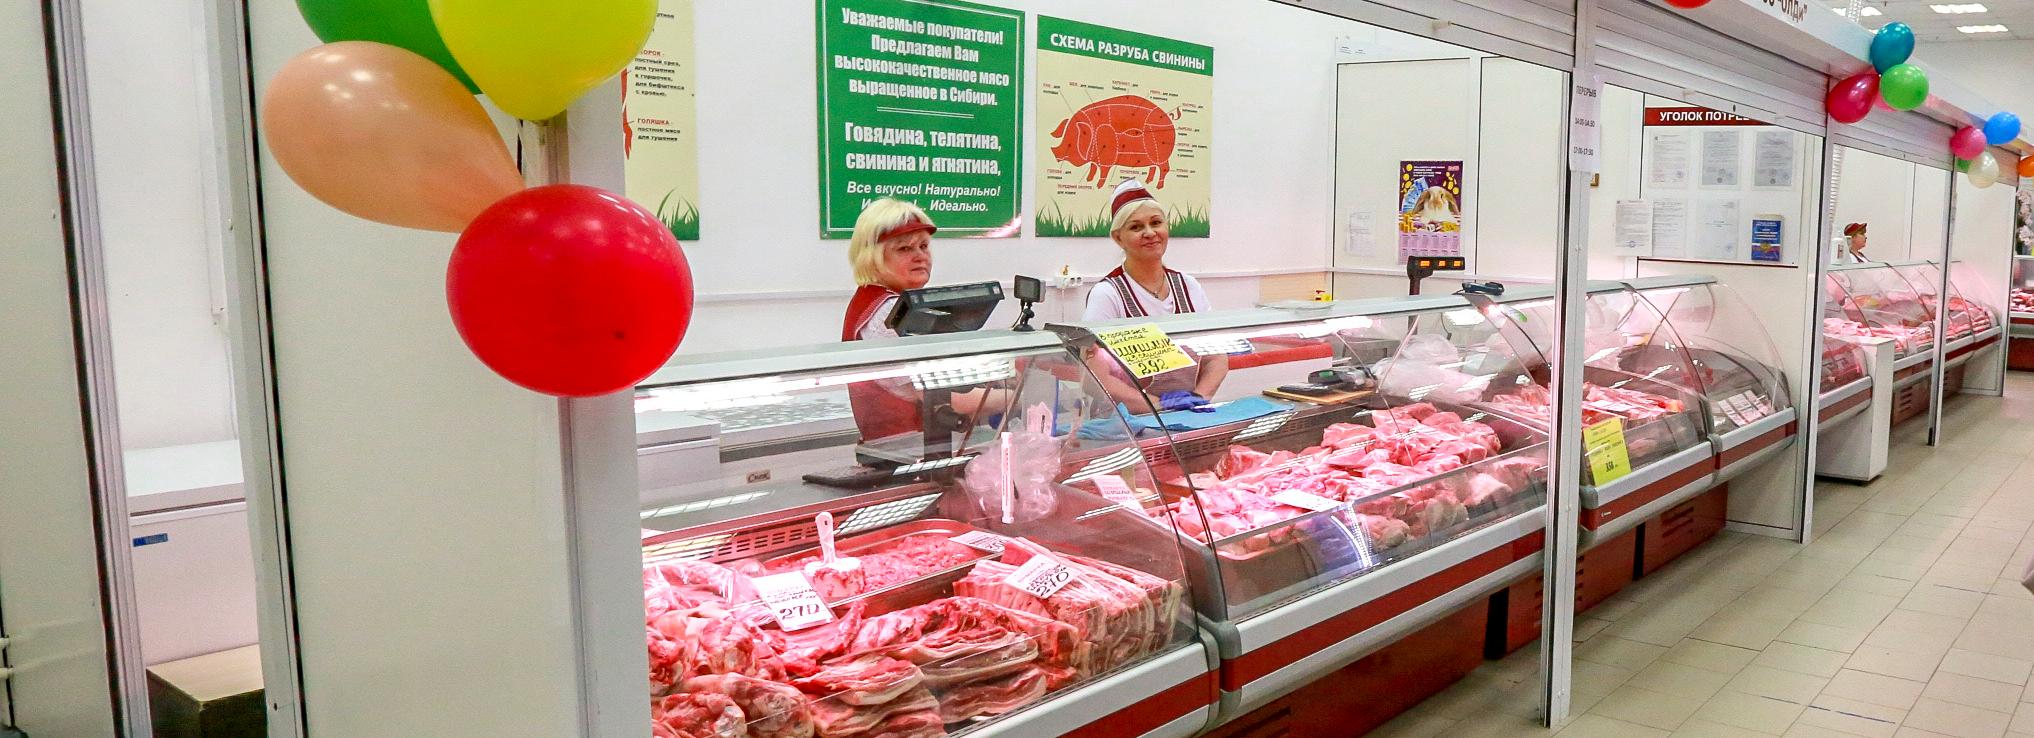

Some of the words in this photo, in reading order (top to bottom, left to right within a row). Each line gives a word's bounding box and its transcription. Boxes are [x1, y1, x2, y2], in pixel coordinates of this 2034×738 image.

[842, 8, 925, 34] Уважаемые
[926, 22, 1004, 45] покупатели!
[871, 34, 952, 60] Предлагаем
[954, 46, 979, 62] Вам
[1050, 33, 1095, 52] СХЕМА
[1098, 41, 1150, 61] РАЗРУБА
[1152, 50, 1205, 70] СВИНИНЫ
[834, 55, 977, 83] высококачественное
[979, 73, 1010, 86] мясо
[848, 79, 938, 101] выращенное
[940, 90, 948, 101] в
[949, 86, 998, 106] Сибири.
[1576, 86, 1597, 98] ПЕРЕРЫВ
[1660, 112, 1702, 122] УГОЛОК
[844, 122, 927, 147] Говядина,
[930, 131, 1002, 152] телятина,
[846, 152, 916, 172] свинина
[919, 157, 929, 172] и
[932, 158, 1001, 176] ягнятина,
[847, 181, 872, 194] Все
[875, 184, 922, 196] вкусно!
[924, 184, 1001, 197] Натурально!
[930, 200, 989, 212] Идеально.
[1138, 358, 1169, 375] 292
[1036, 572, 1069, 596] 270
[779, 604, 820, 620] 270
